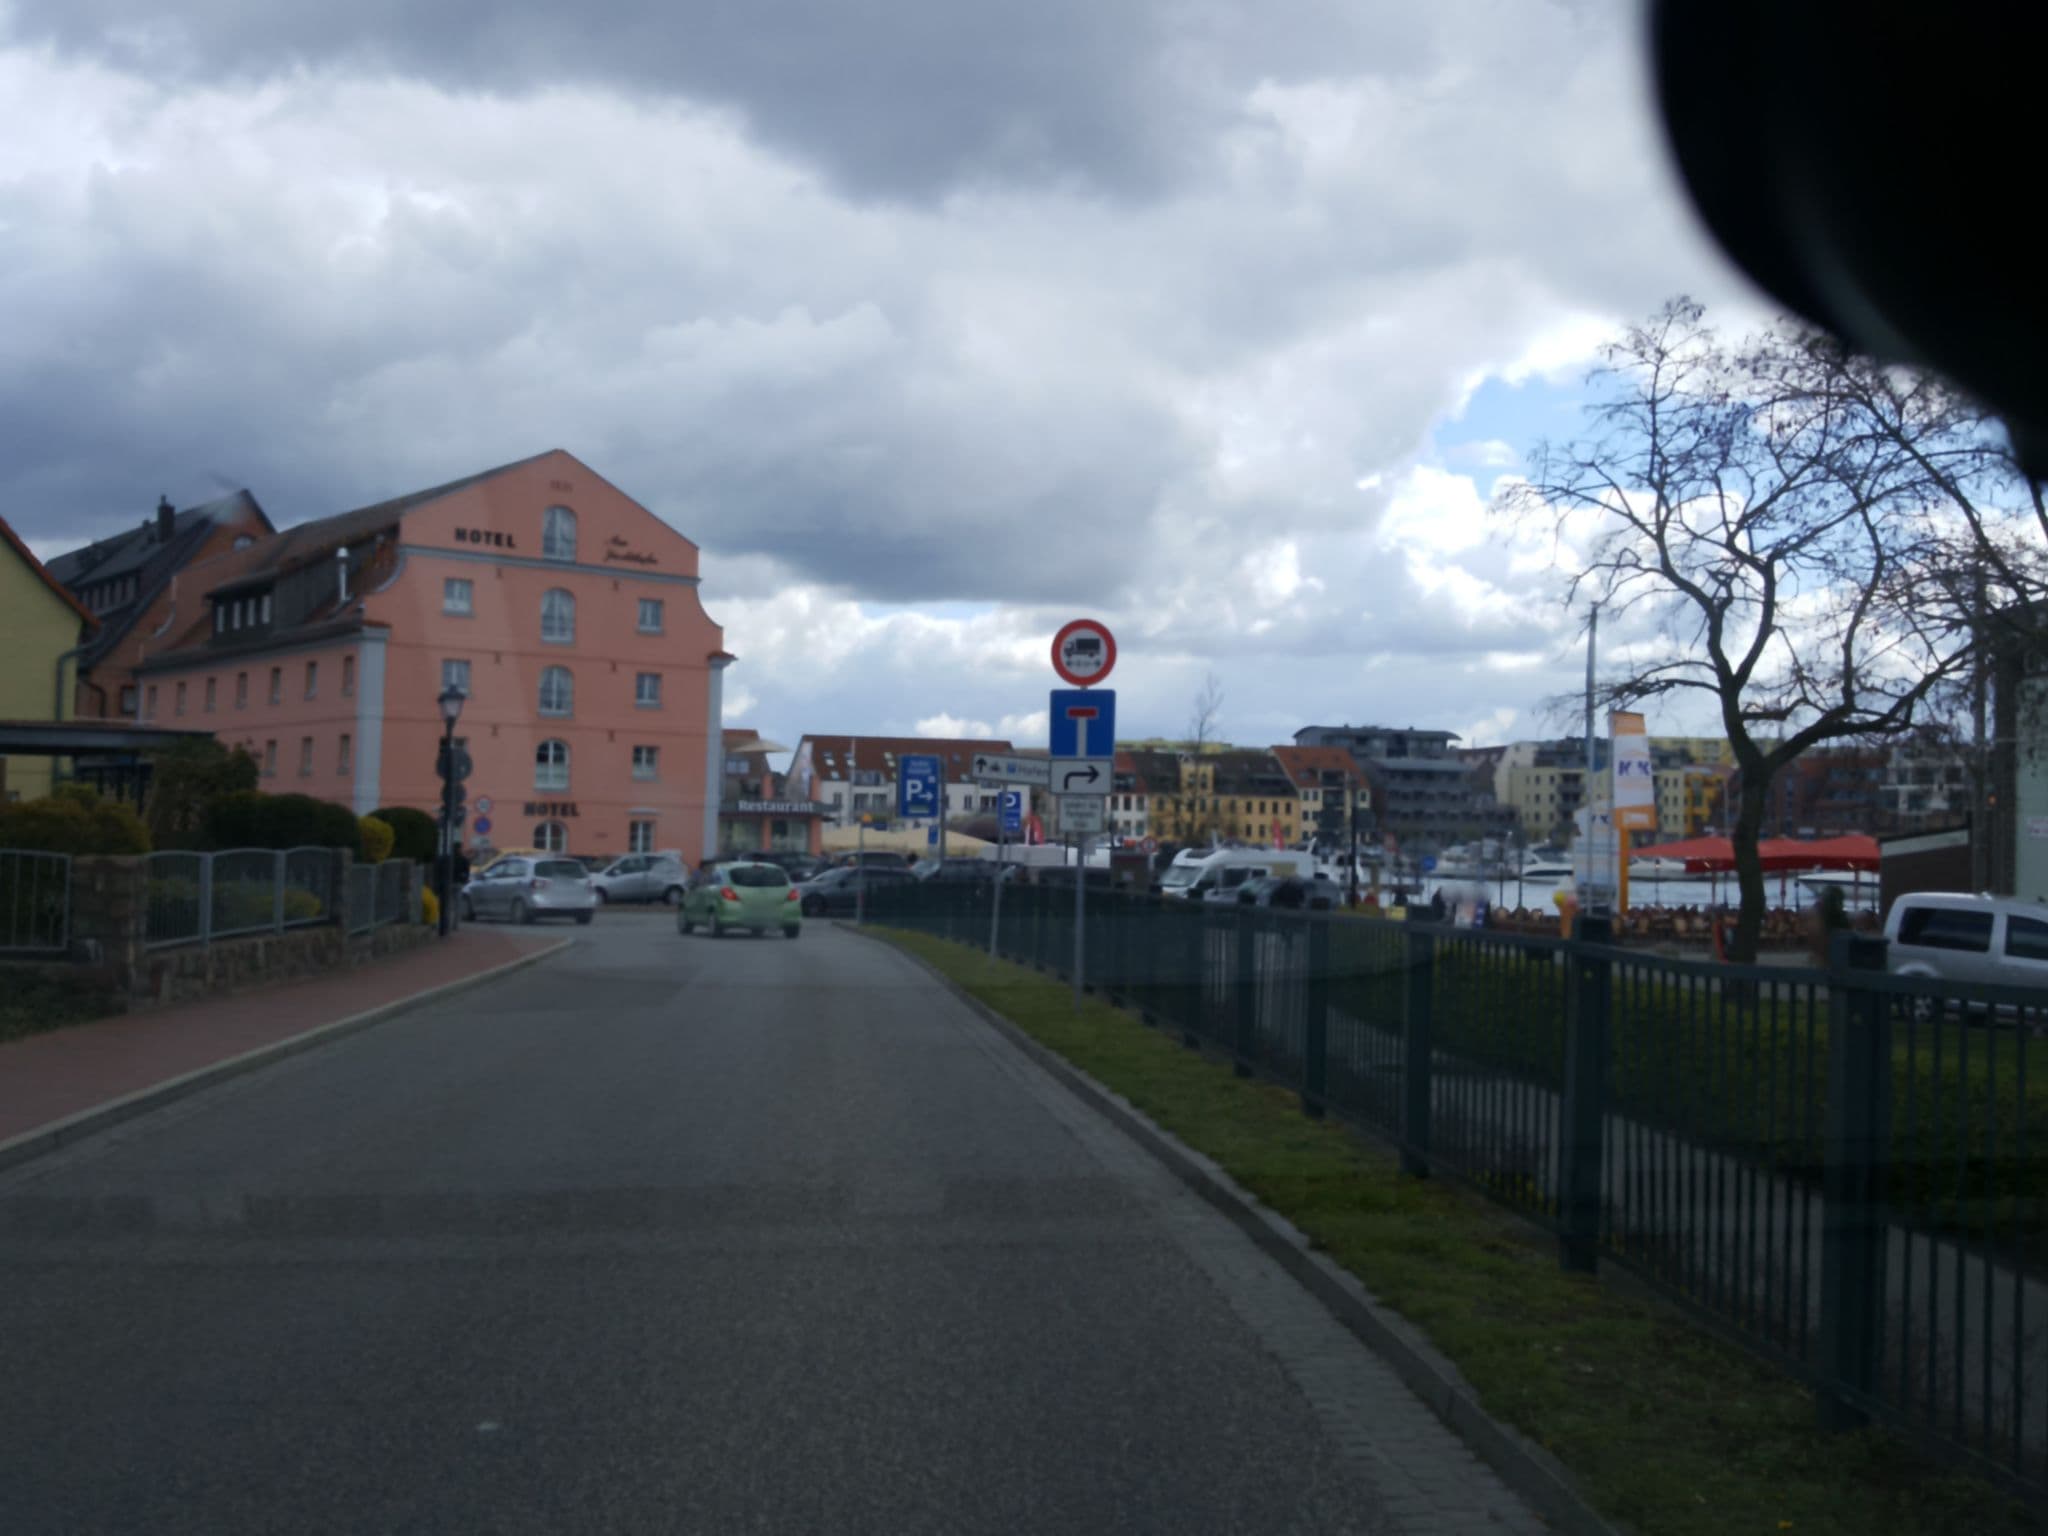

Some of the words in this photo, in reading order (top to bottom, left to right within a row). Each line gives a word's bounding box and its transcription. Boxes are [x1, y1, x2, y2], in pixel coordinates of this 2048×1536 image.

[455, 528, 515, 548] HOTEL
[906, 780, 923, 802] P
[524, 802, 580, 817] HOTEL
[738, 800, 814, 812] Restaurant
